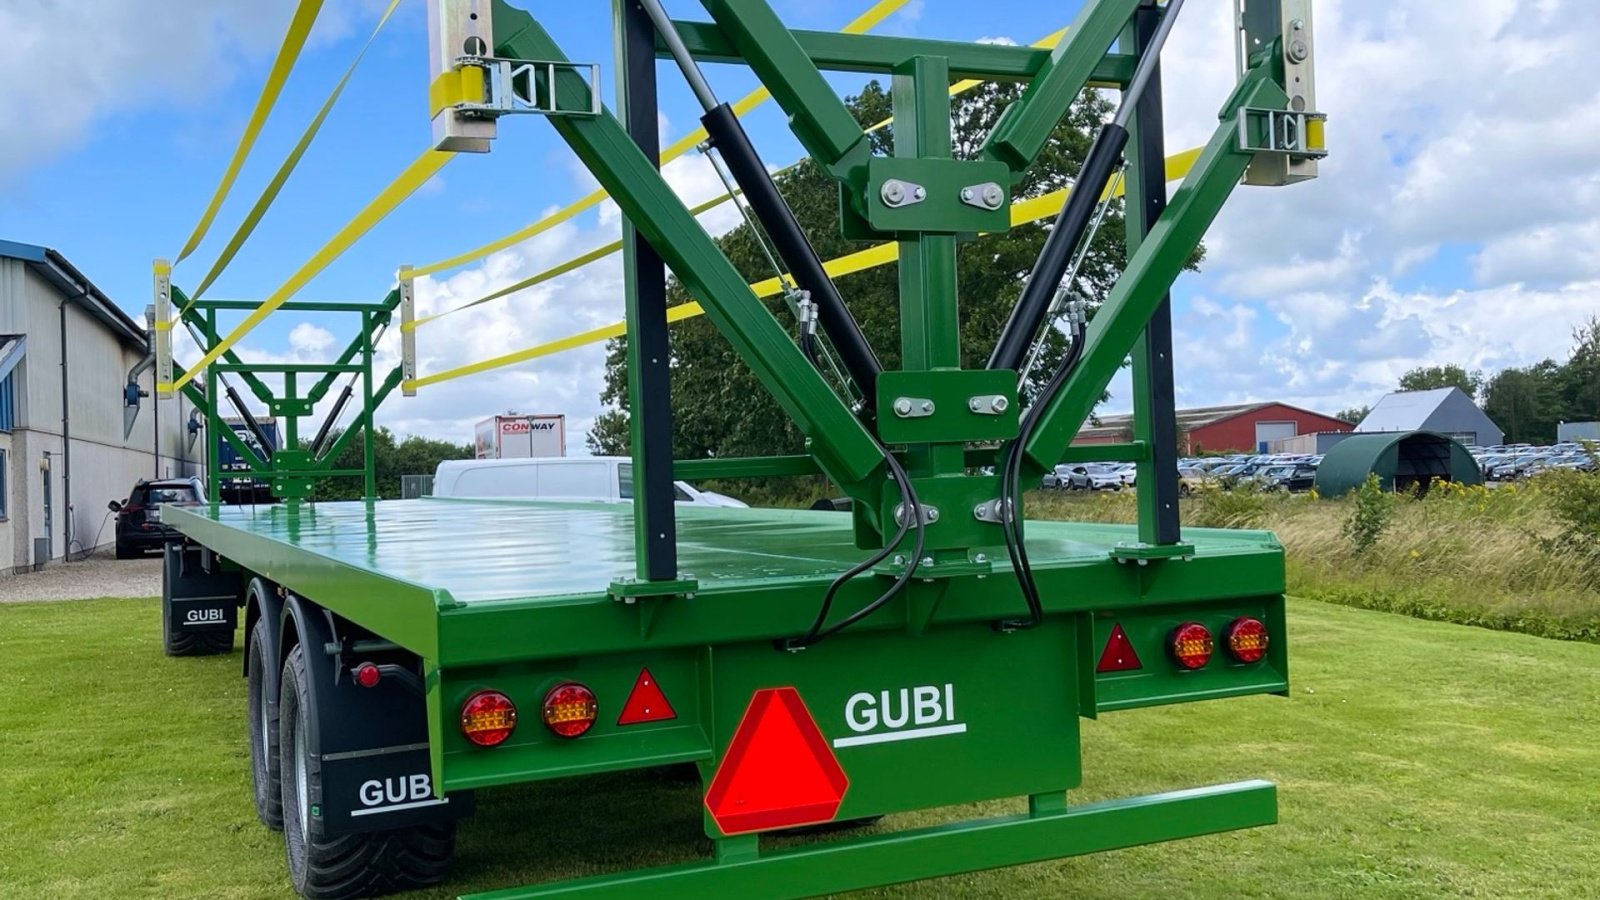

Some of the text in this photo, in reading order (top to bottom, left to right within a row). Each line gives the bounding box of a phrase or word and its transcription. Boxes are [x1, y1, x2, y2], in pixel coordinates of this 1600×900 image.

[503, 422, 554, 431] CONWAY
[187, 608, 223, 621] GUBI
[845, 683, 955, 732] GUBI
[360, 774, 435, 806] GUB
